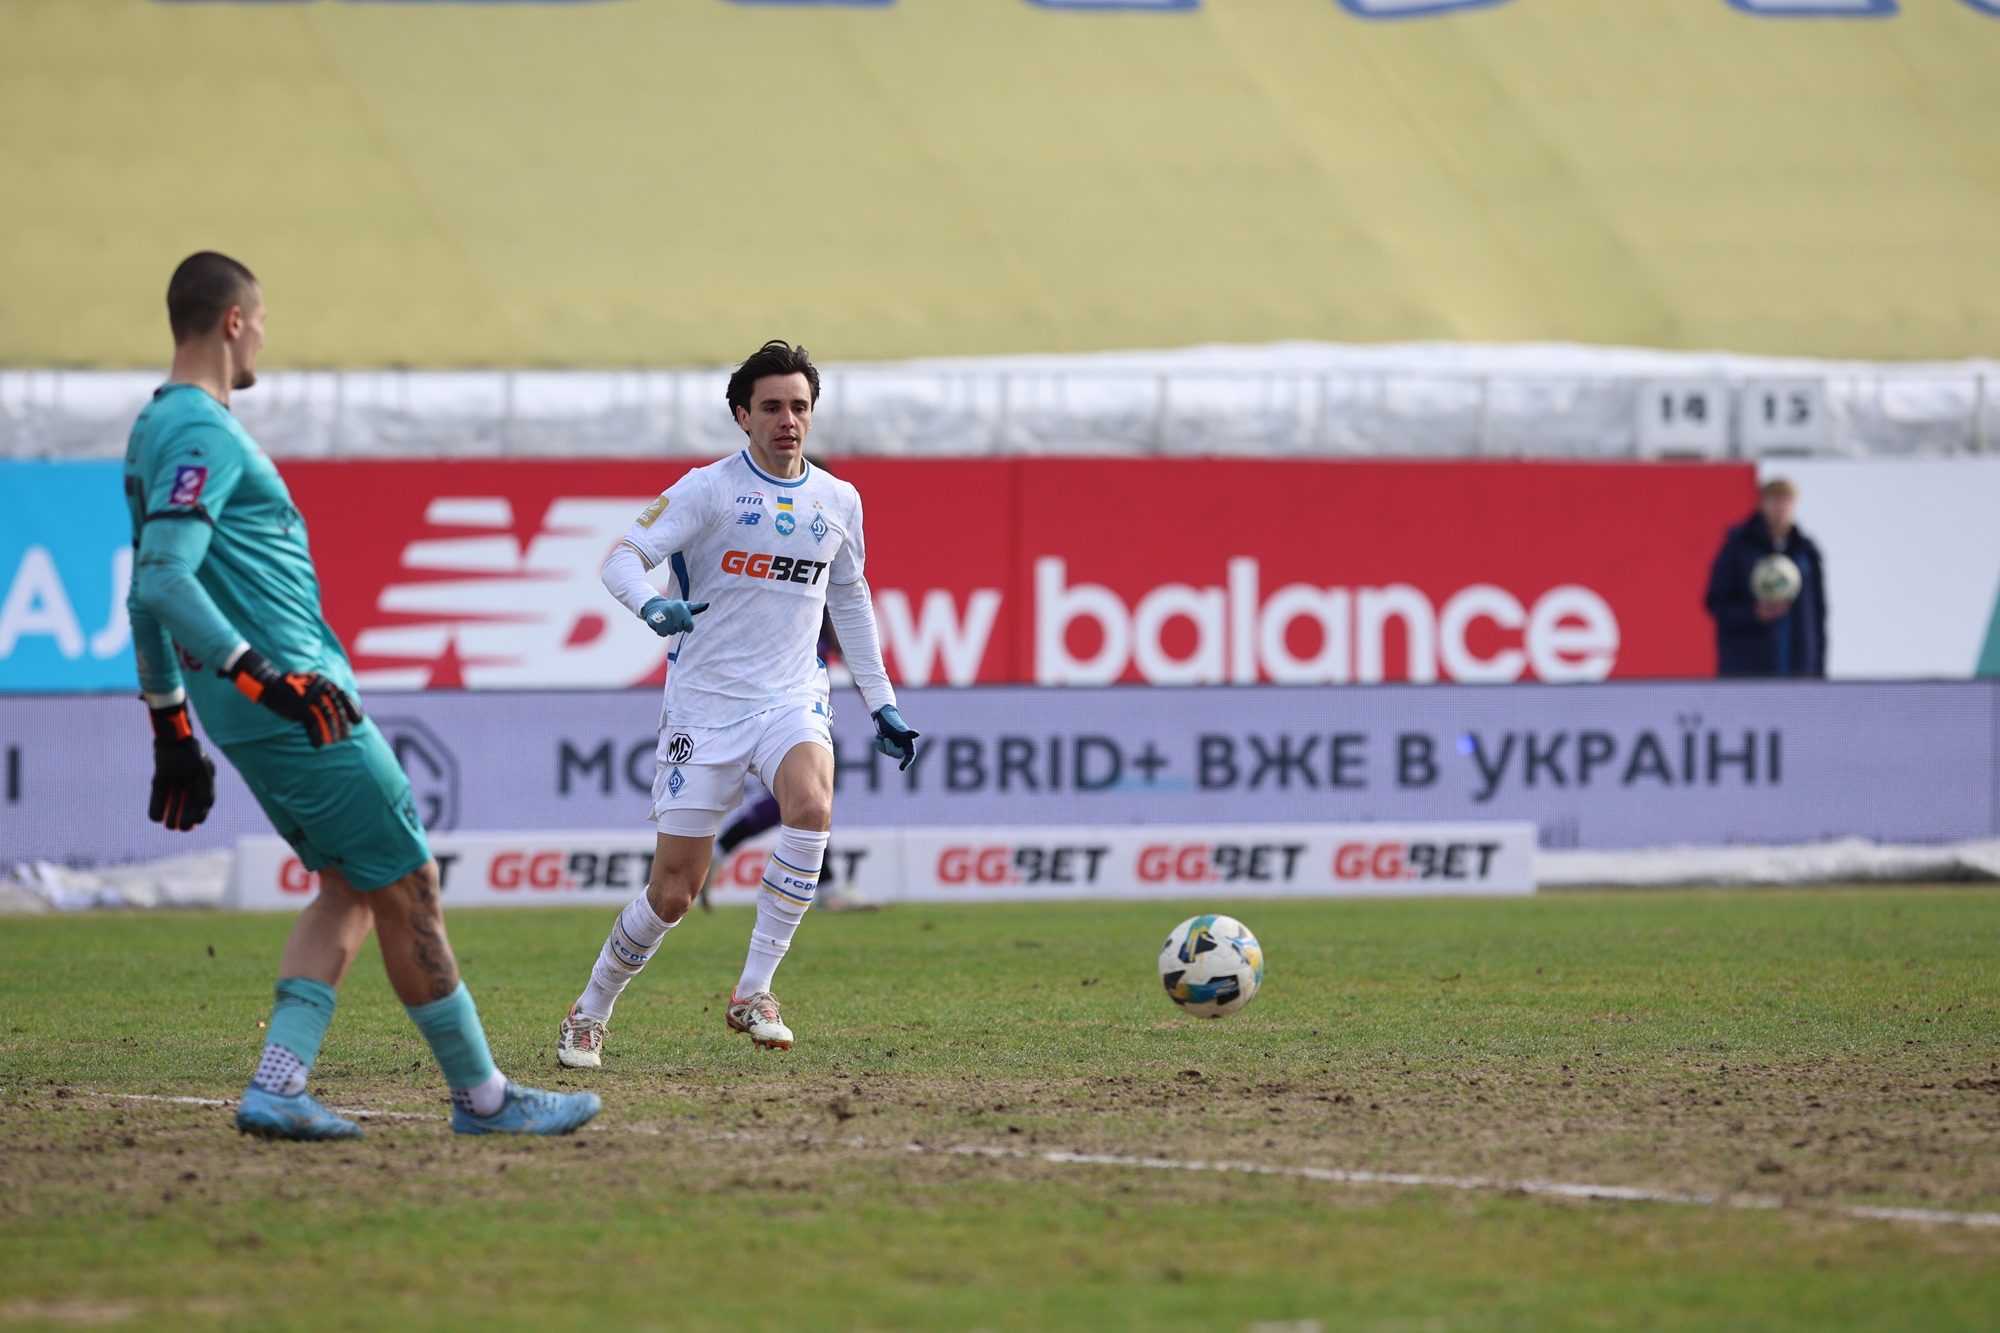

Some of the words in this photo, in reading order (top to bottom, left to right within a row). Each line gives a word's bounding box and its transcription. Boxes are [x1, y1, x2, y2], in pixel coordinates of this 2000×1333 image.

[1662, 392, 1707, 424] 14
[721, 550, 828, 585] GG.BET
[1034, 556, 1620, 686] balance
[834, 734, 1168, 793] HYBRID+
[1199, 733, 1368, 790] ВЖЕ
[1398, 732, 1440, 788] В
[937, 845, 1110, 886] GG.BET
[1137, 843, 1306, 884] GG.BET
[1333, 842, 1502, 881] GG.BET
